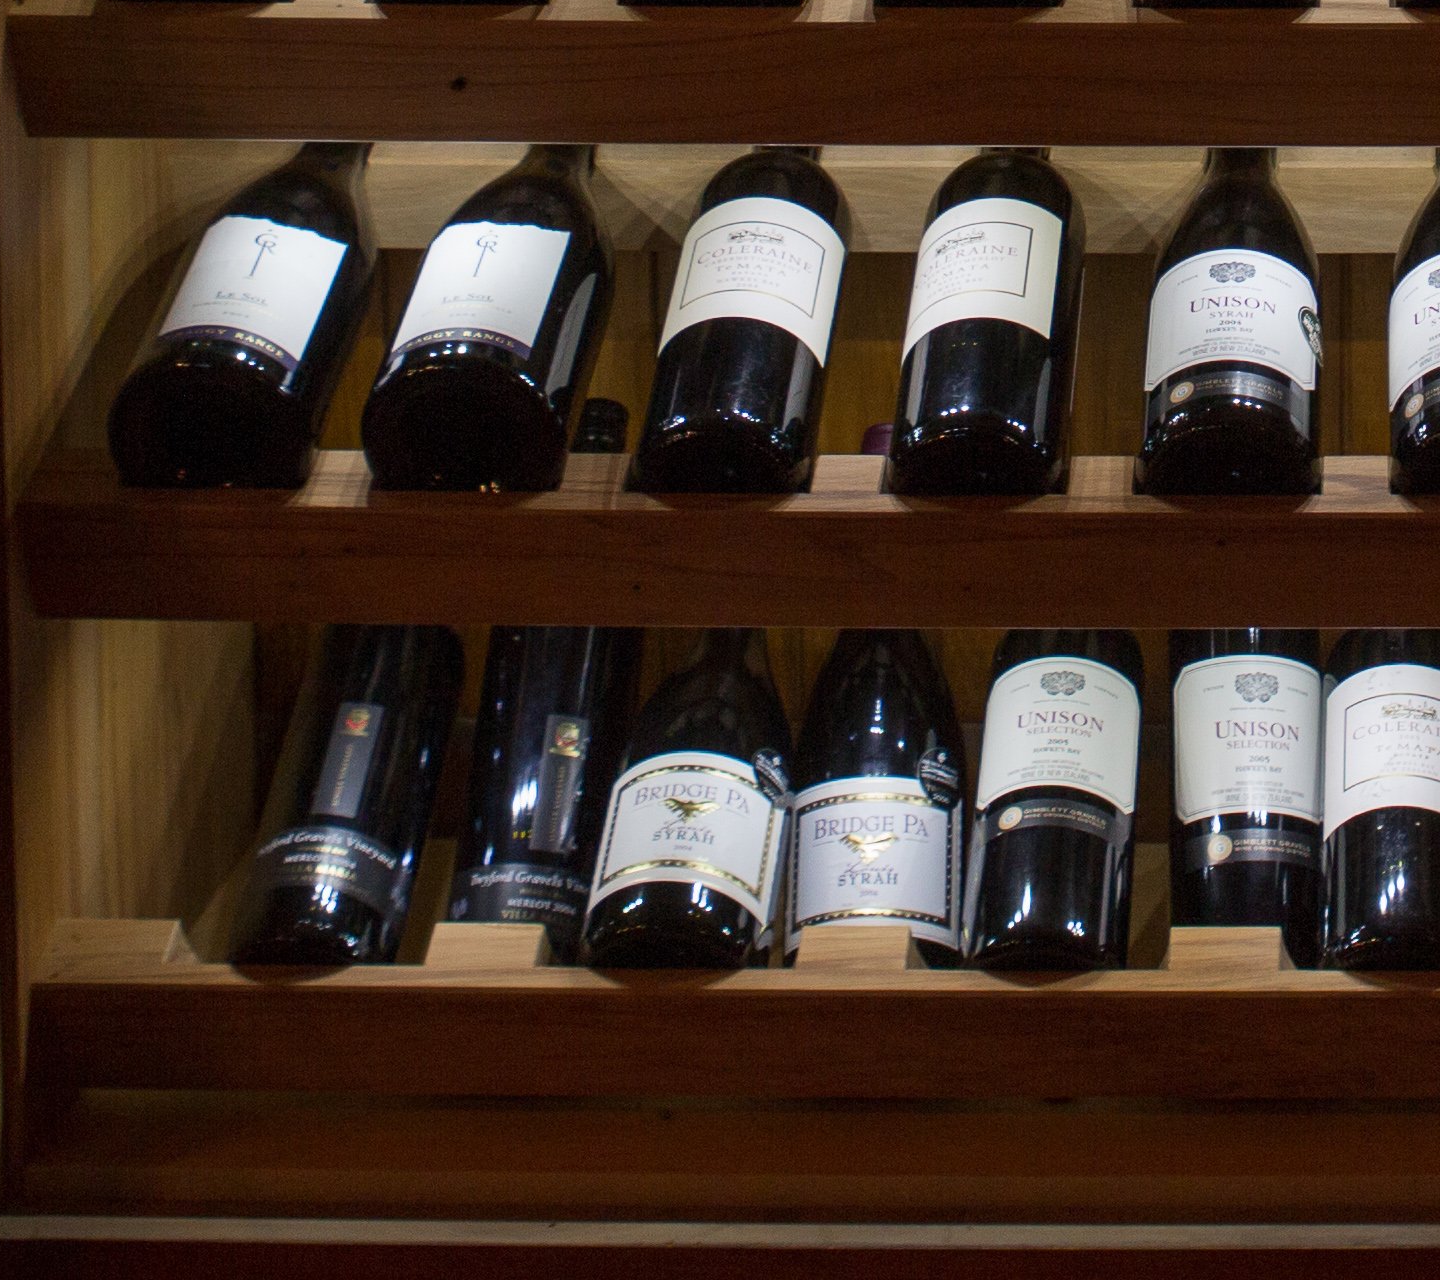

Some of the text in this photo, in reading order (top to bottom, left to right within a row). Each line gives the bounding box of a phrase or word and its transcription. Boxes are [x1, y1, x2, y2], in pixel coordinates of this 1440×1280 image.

[1189, 295, 1278, 315] UNISON
[1016, 710, 1105, 733] UNISON
[1214, 719, 1301, 742] UNISON
[633, 783, 721, 806] BRIDGE
[652, 825, 717, 846] SYRAH
[813, 811, 931, 840] BRIDGE PA
[837, 869, 900, 888] SYRAH
